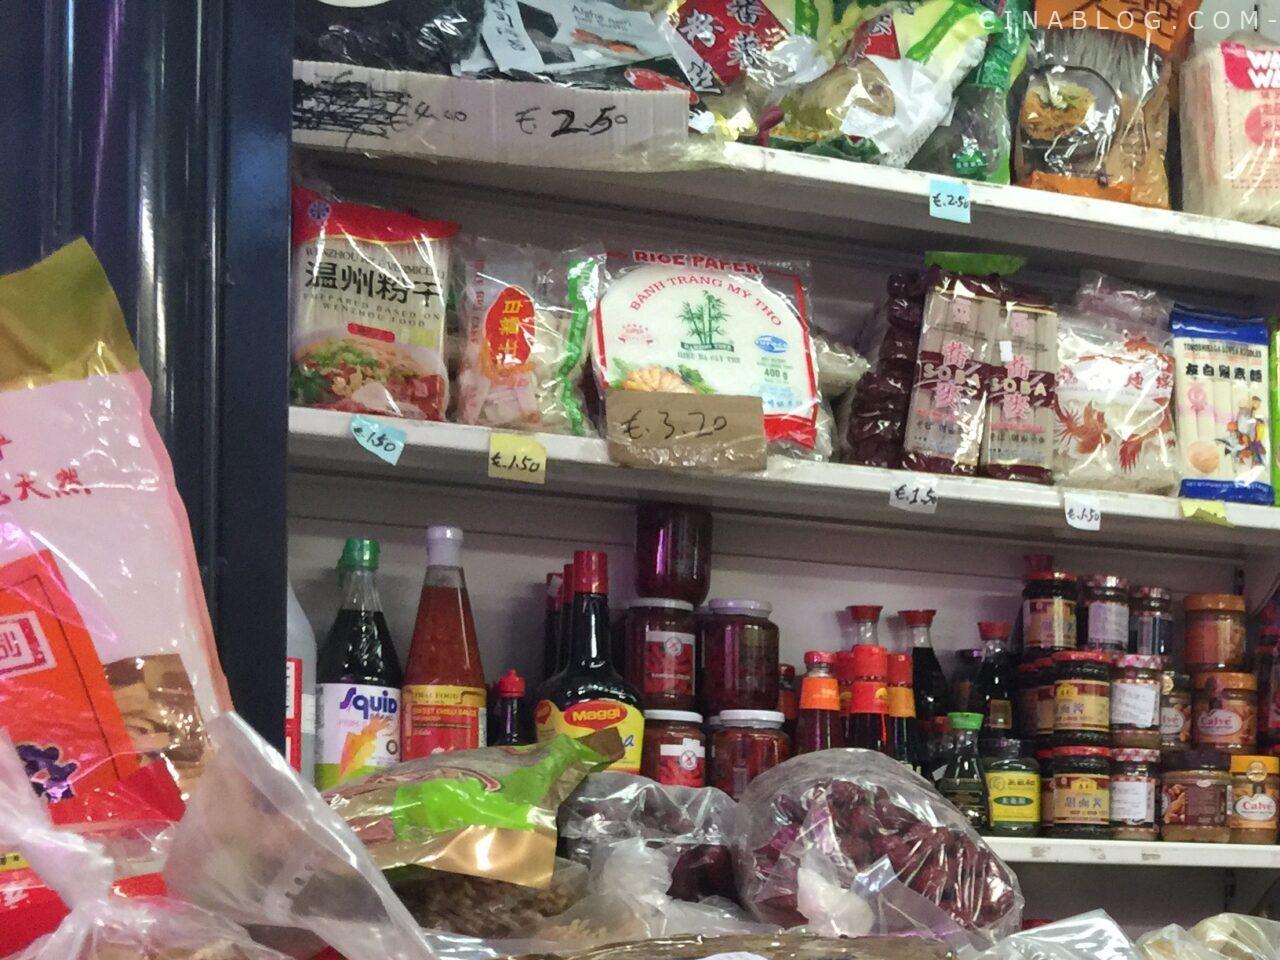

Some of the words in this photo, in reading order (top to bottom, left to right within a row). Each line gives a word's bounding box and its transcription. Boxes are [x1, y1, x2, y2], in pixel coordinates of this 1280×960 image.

[633, 250, 685, 267] RICE
[754, 298, 782, 327] THO
[764, 368, 780, 378] 400
[923, 362, 981, 390] SOBA
[989, 376, 1047, 397] SOBA
[572, 706, 621, 722] Maggi
